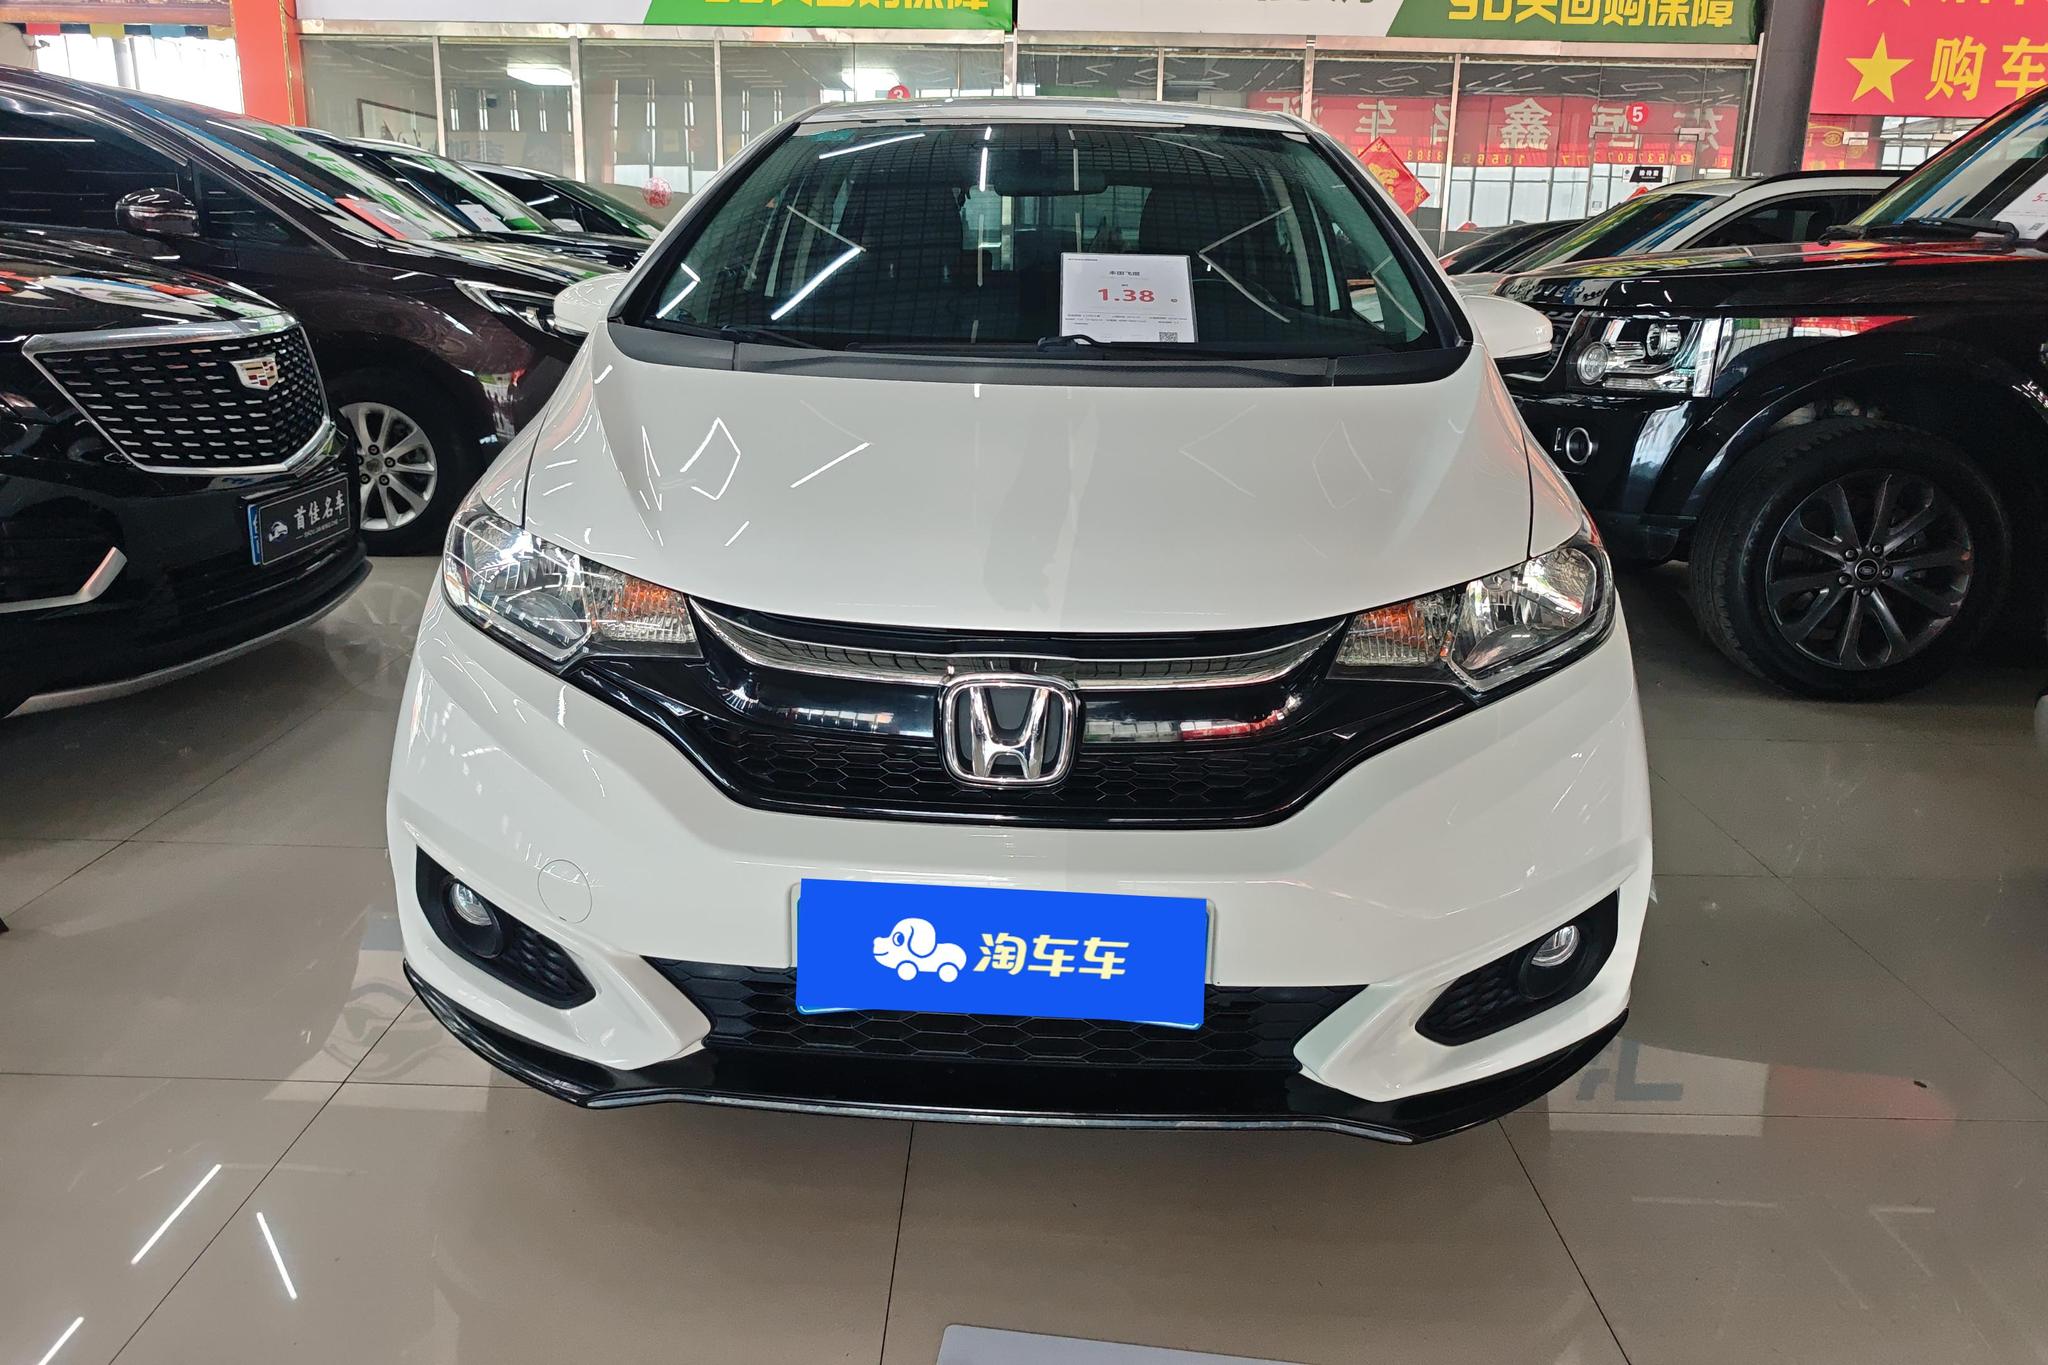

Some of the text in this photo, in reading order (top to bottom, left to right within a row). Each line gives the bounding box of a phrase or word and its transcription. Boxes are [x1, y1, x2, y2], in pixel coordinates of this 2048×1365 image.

[1924, 35, 2048, 101] 购车
[1632, 106, 1643, 122] 5
[1098, 288, 1155, 303] 1.38
[293, 489, 345, 530] 首佳名车
